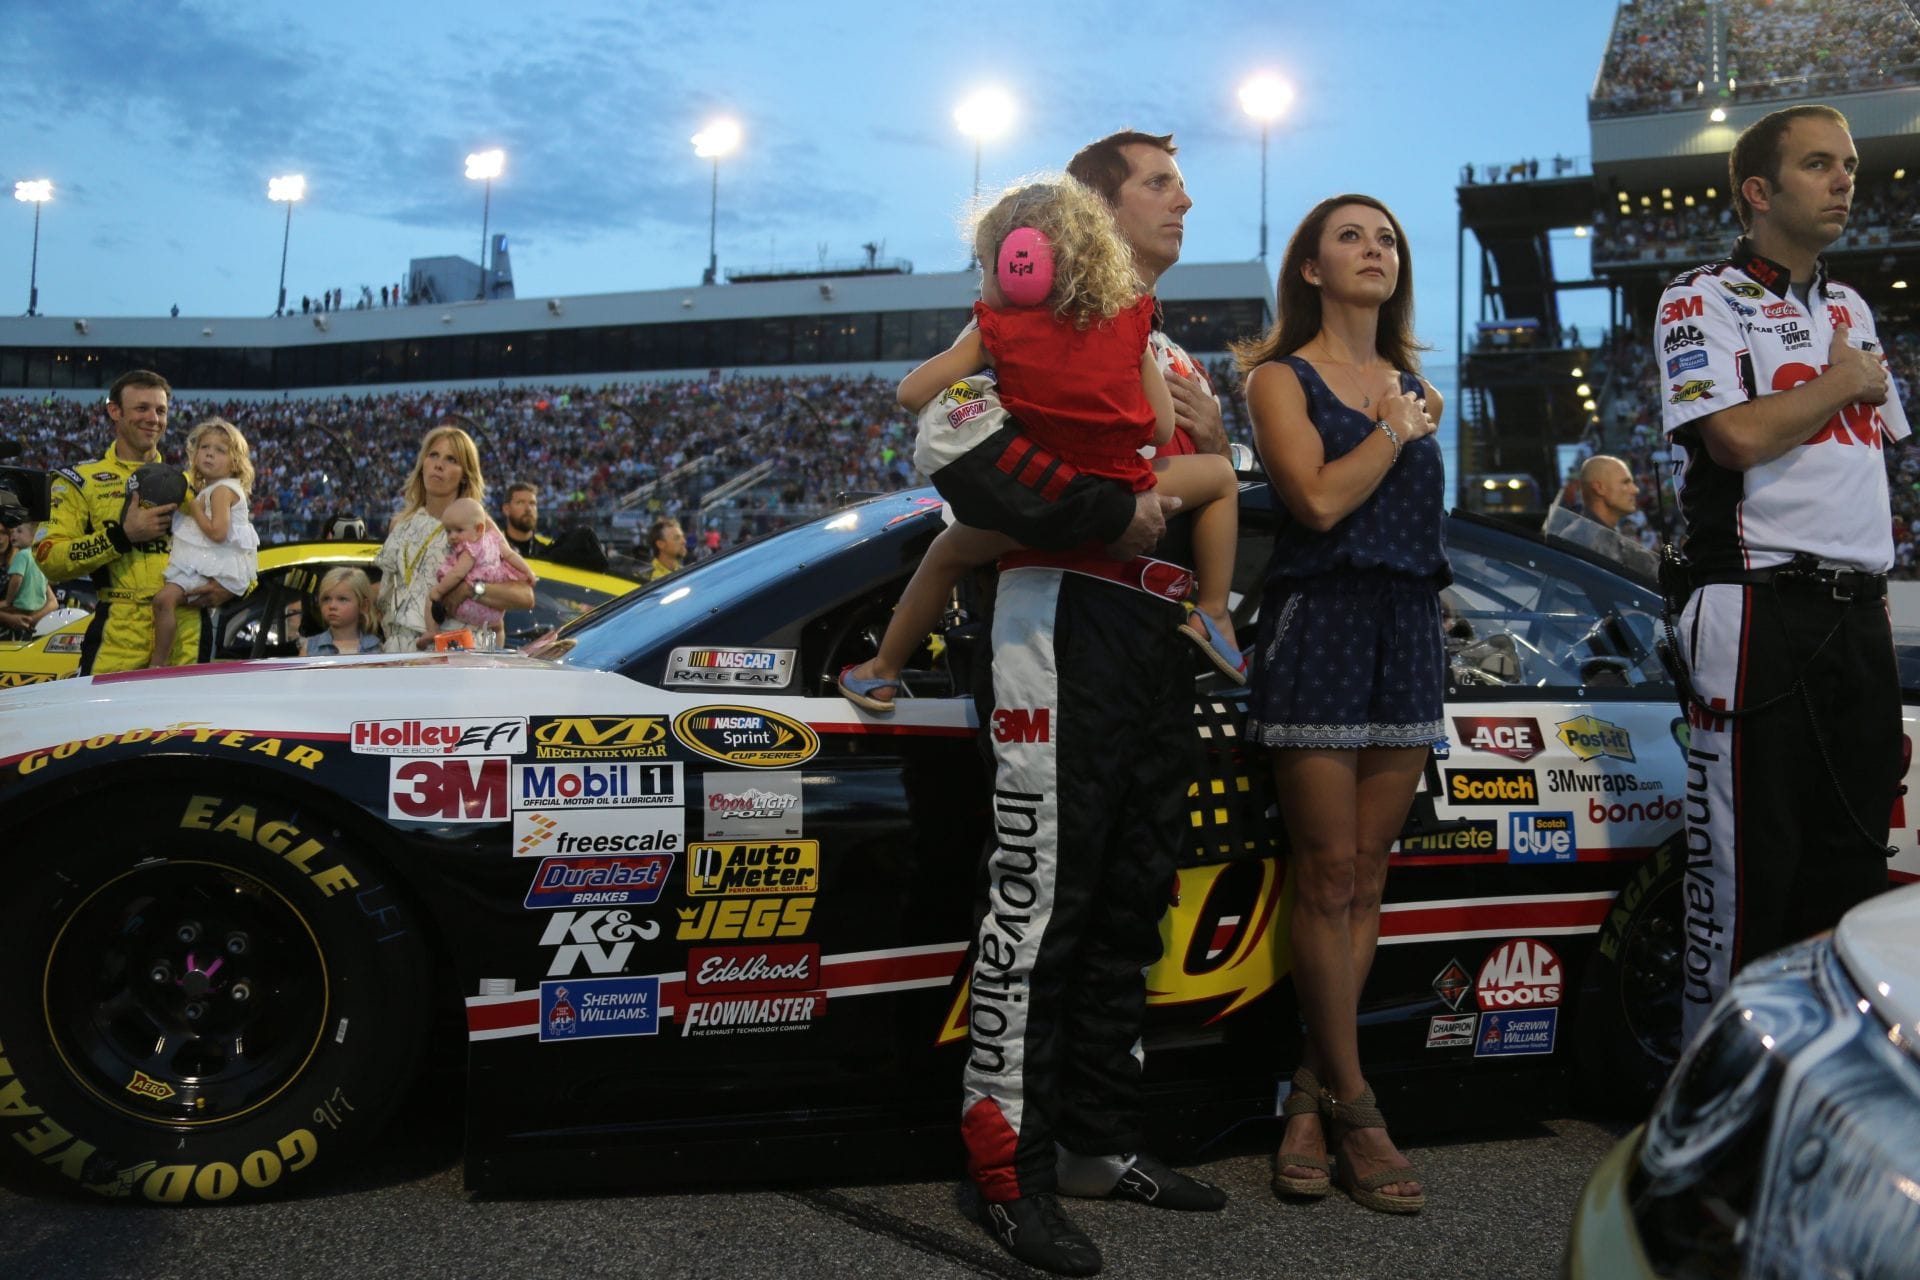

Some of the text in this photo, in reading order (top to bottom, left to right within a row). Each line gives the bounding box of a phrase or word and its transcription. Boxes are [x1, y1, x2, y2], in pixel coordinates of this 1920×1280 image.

[1015, 250, 1028, 259] 3M
[1009, 261, 1034, 276] kid
[1661, 295, 1704, 325] 3M
[1664, 325, 1704, 349] MAC
[1774, 321, 1798, 334] ECO
[1781, 329, 1811, 345] POWER
[1665, 340, 1706, 355] TOOLS
[1672, 380, 1712, 402] SUNOCO
[951, 402, 985, 426] SIMPSON
[70, 543, 113, 561] GENERAL
[716, 652, 772, 669] NASCAR
[673, 670, 780, 682] RACE CAR
[714, 716, 762, 730] NASCAR
[993, 708, 1052, 743] 3M
[355, 721, 521, 754] Holley EFI
[724, 731, 770, 748] Sprint
[1471, 726, 1532, 749] ACE
[1566, 728, 1625, 750] Post-it
[17, 725, 325, 777] GOODYEAR
[536, 744, 668, 759] MECHANIX WEAR
[731, 752, 801, 760] CUP SERIES
[393, 759, 508, 819] 3M
[523, 764, 628, 798] Mobil
[1451, 775, 1534, 800] Scotch
[1548, 769, 1664, 793] 3Mwraps.com
[524, 795, 674, 807] OFFICIAL MOTOR OIL & LUBRICANTS
[708, 792, 798, 812] Coors LIGHT
[1587, 796, 1681, 825] bondo
[721, 809, 786, 820] POLE
[1535, 819, 1567, 831] Scotch
[180, 794, 360, 898] EAGLE
[556, 829, 678, 855] freescale
[1513, 817, 1571, 857] blue
[727, 844, 801, 867] Auto
[541, 860, 662, 888] Duralast
[718, 866, 815, 893] Meter
[1685, 746, 1725, 1006] Innovation
[572, 892, 628, 904] BRAKES
[728, 885, 810, 894] PERFORMANCE GAUGES
[1600, 843, 1673, 961] EAGLE
[676, 897, 816, 941] JEGS
[970, 790, 1044, 1075] Innovation
[696, 953, 810, 985] Edelbrock
[1478, 941, 1561, 989] MAC
[581, 992, 648, 1007] SHERWIN
[1479, 986, 1561, 1007] TOOLS
[580, 1008, 647, 1022] WILLIAMS
[681, 997, 816, 1037] FLOWMASTER
[1505, 1020, 1550, 1032] SHERWIN
[692, 1024, 811, 1037] THE EXHAUST TECHNOLOGY COMPANY
[1433, 1020, 1472, 1033] CHAMPION
[1503, 1031, 1550, 1044] WILLIAMS
[1429, 1038, 1471, 1048] SPARK PLUGS
[134, 1077, 168, 1098] AERO
[0, 1036, 320, 1204] GOODYEA
